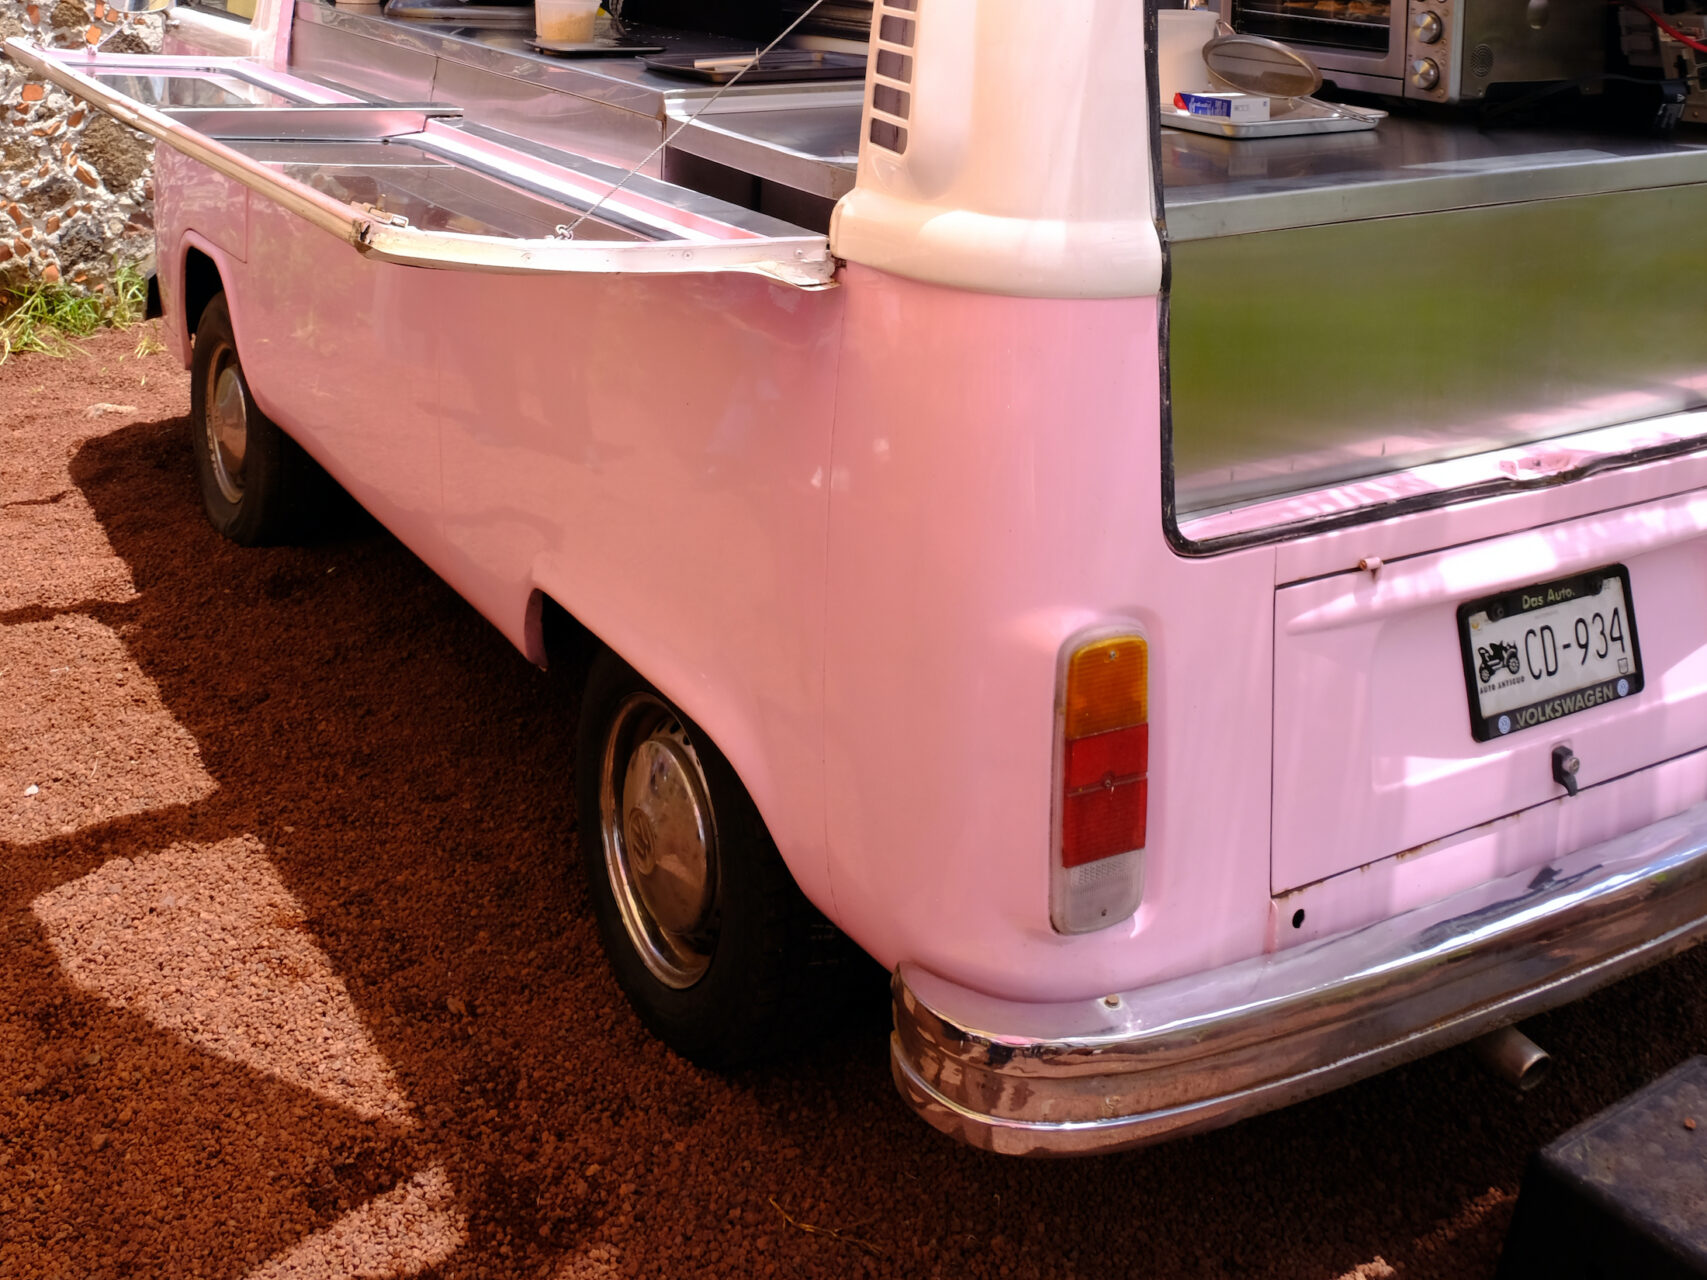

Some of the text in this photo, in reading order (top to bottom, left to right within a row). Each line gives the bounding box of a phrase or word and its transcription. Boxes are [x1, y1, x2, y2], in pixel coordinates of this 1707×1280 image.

[1522, 588, 1575, 609] Das Auto.
[1524, 607, 1626, 680] CD-934
[1480, 675, 1525, 694] AUTO ANTIGUO
[1516, 683, 1613, 727] VOLKSWAGEN
